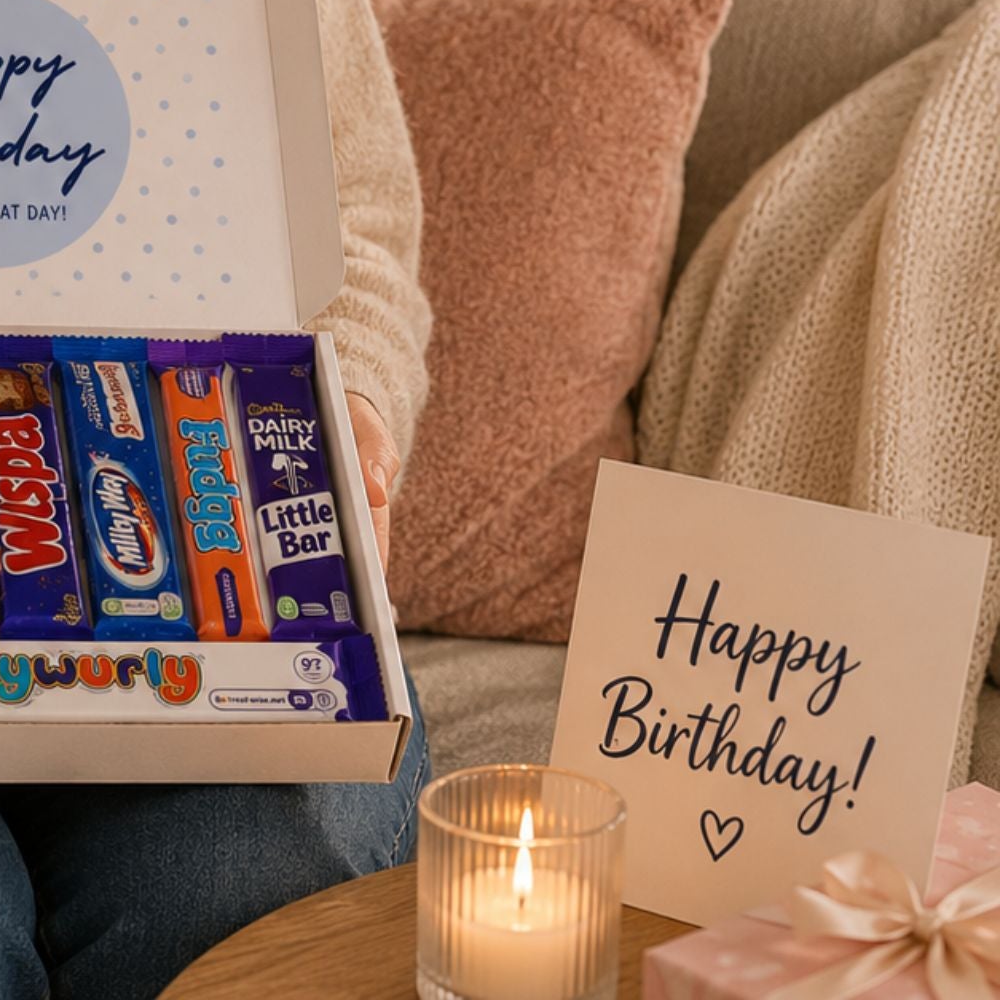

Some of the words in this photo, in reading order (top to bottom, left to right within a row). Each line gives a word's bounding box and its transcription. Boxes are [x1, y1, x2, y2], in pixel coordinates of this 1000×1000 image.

[27, 204, 67, 222] DAY!
[254, 434, 317, 452] MILK
[261, 498, 334, 534] Little
[277, 531, 331, 559] Bar
[654, 572, 862, 717] Happy
[598, 674, 877, 836] Birthday!
